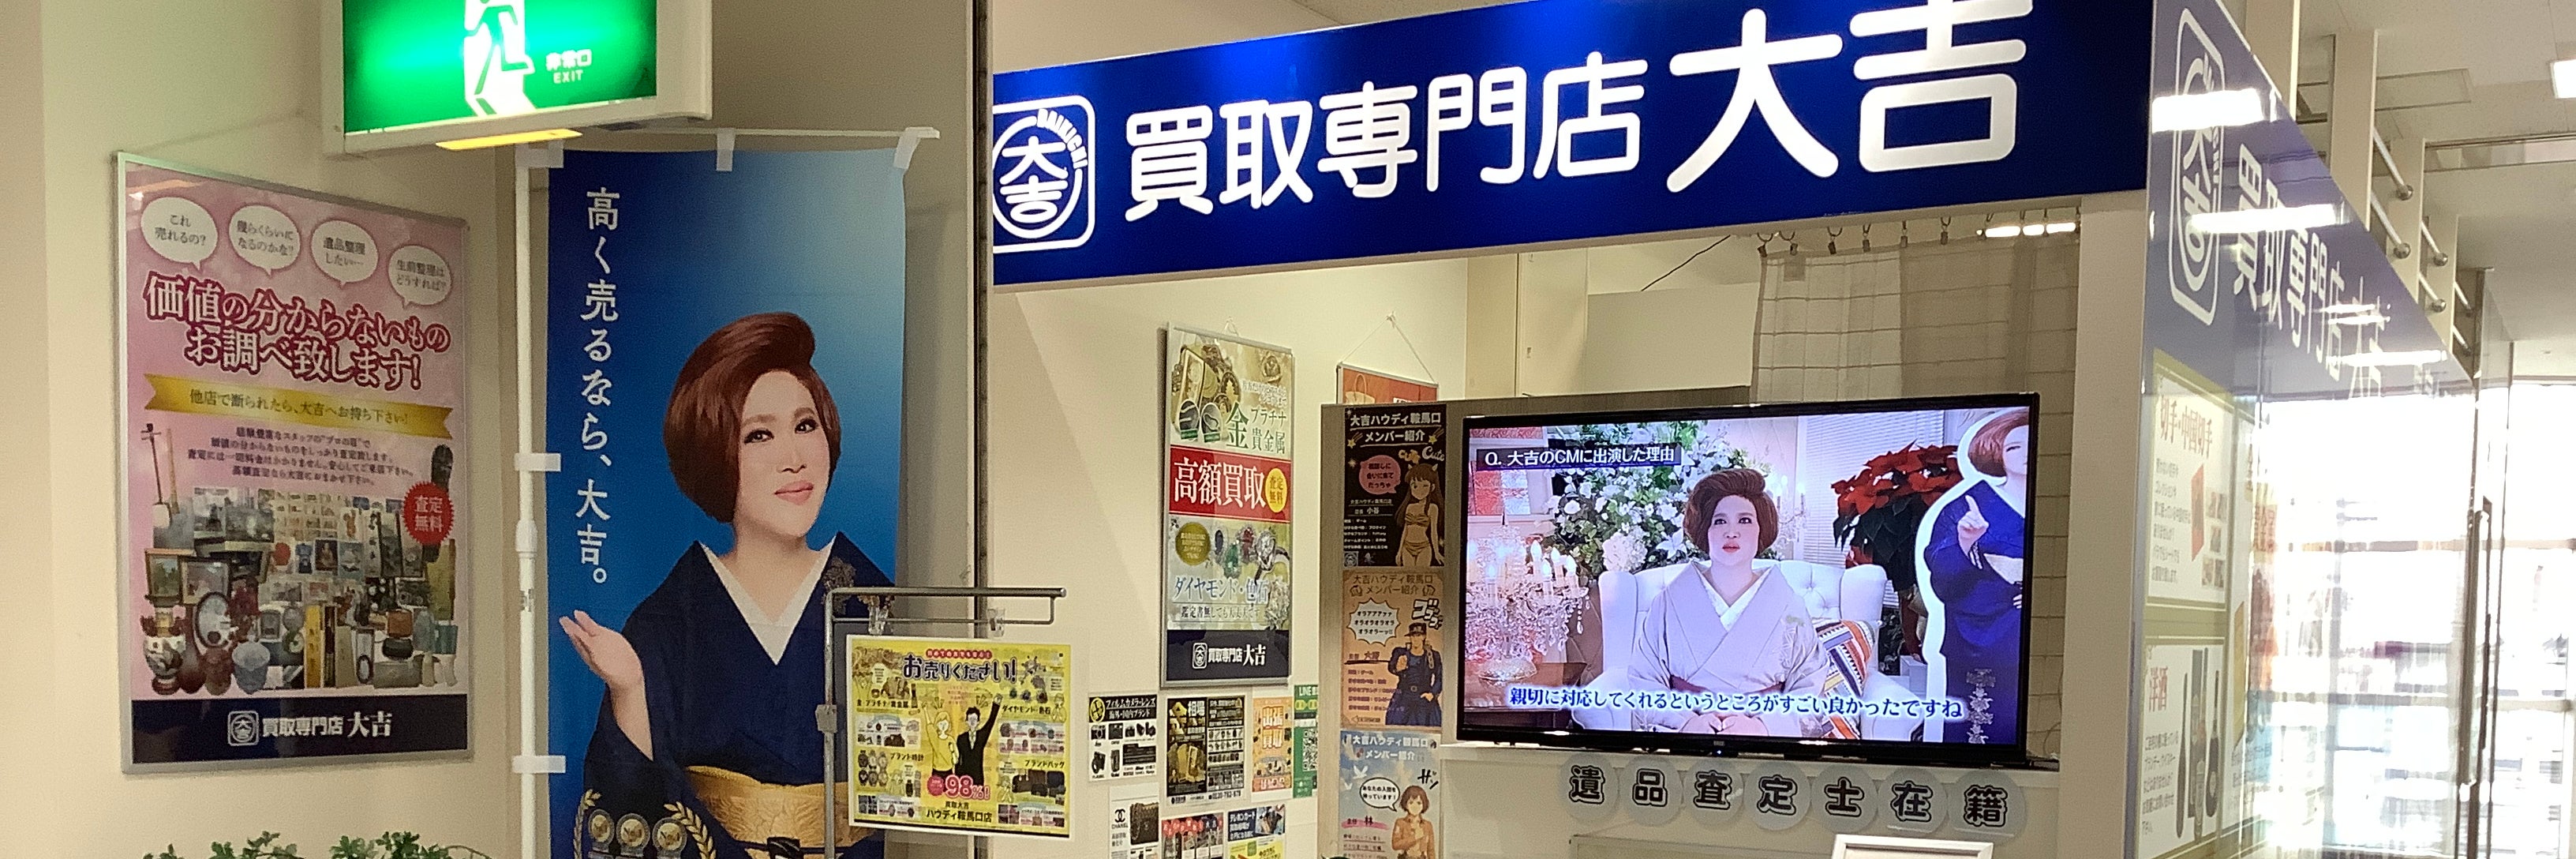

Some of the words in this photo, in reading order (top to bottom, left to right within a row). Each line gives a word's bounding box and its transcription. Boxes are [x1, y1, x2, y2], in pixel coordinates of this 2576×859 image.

[545, 48, 592, 71] 非常口
[553, 69, 584, 84] EXIT
[1125, 50, 1649, 222] 買取専門店
[1666, 0, 2034, 193] 大吉
[999, 135, 1069, 224] 大吉
[169, 214, 192, 227] これ
[144, 273, 451, 351] 価値の分からないもの
[187, 329, 421, 389] お調べ致します!
[575, 186, 620, 584] 高く売るなら、大吉。
[1226, 401, 1249, 449] 金
[1251, 408, 1286, 427] プラチナ
[1350, 412, 1441, 427] 大吉ハウディ鞍馬口
[1252, 426, 1286, 455] 貴金属
[1365, 429, 1425, 443] メンバー紹介
[1507, 445, 1675, 467] 大吉のCMに出演した理由
[1174, 456, 1267, 510] 高額買取
[414, 495, 443, 513] 査定
[414, 513, 444, 533] 無料
[1366, 584, 1419, 595] メンバー紹介
[1208, 647, 1243, 663] 買取専門店
[1243, 643, 1267, 666] 大吉
[1509, 686, 1964, 719] 親切に対応してくれるというところがすごい良かったですね
[262, 716, 343, 737] 買取専門店
[347, 711, 393, 738] 大吉
[1570, 764, 2009, 827] 遺品査定士在籍
